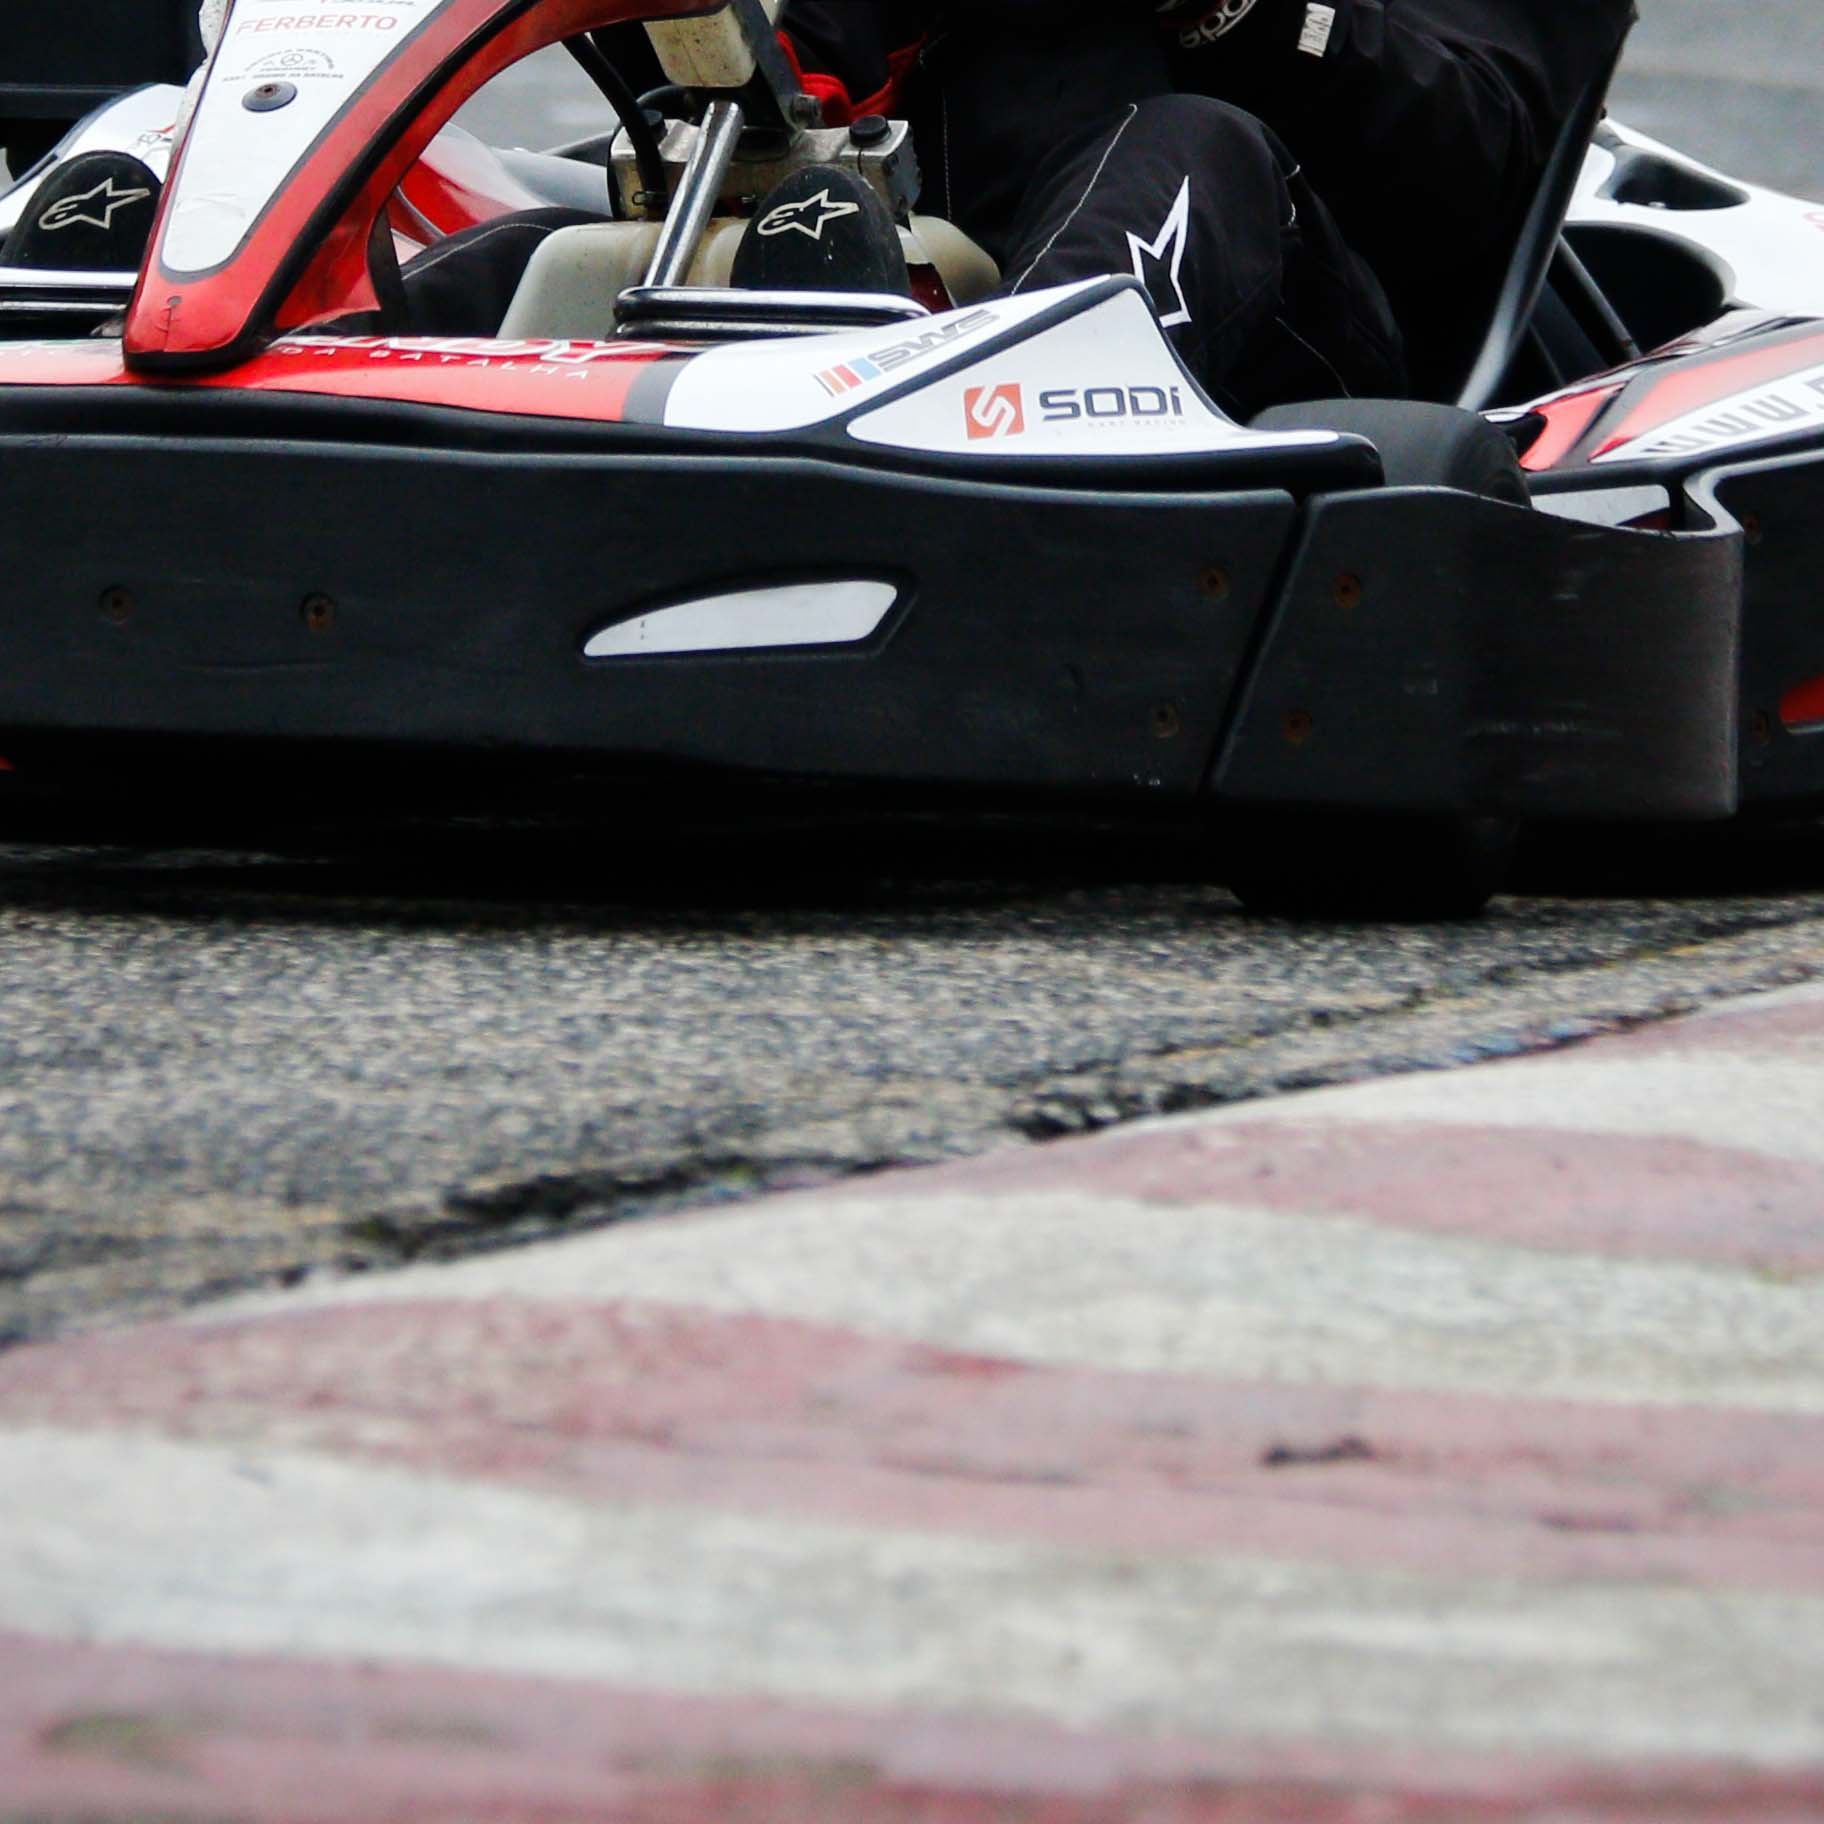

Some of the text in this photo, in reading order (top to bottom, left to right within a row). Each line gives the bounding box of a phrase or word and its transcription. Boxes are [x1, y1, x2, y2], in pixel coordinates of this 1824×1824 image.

[236, 14, 399, 34] FERBERTO
[867, 308, 1001, 369] SWS
[369, 351, 589, 380] BATALHA
